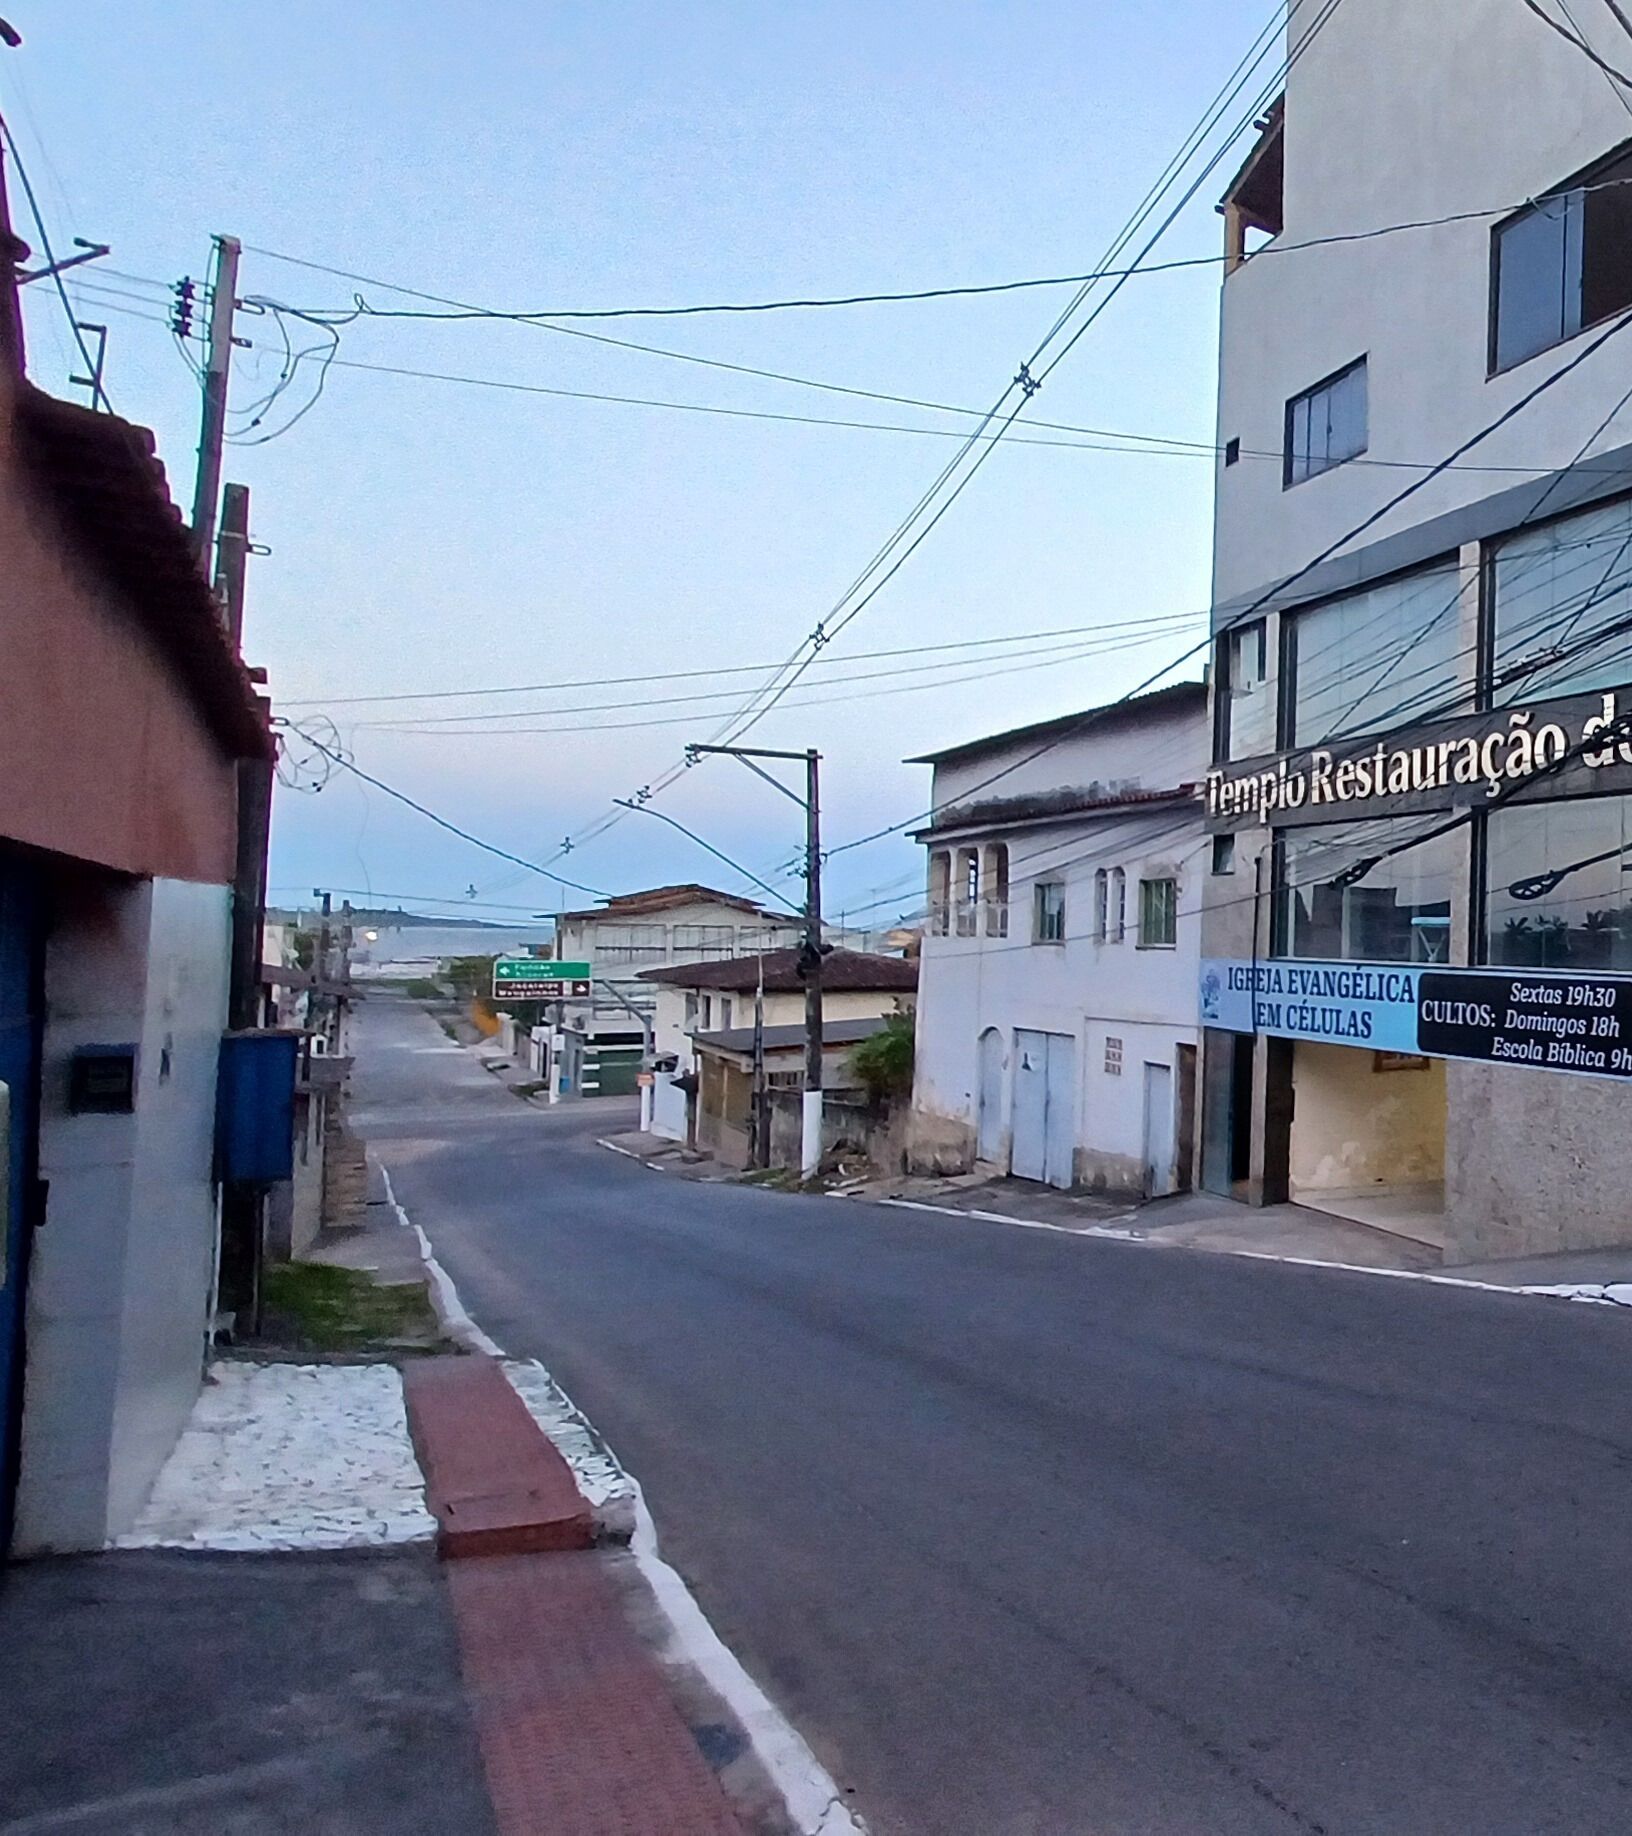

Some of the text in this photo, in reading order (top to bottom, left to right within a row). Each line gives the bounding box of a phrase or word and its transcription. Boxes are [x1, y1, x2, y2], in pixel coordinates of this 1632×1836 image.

[1206, 752, 1304, 824] Templo
[1310, 711, 1567, 798] Restauração
[1227, 964, 1415, 1004] IGREJA EVANGÉLICA
[1510, 982, 1616, 1008] Sextas 19h30
[1256, 999, 1372, 1039] EM CÉLULAS
[1421, 999, 1496, 1028] CULTOS:
[1504, 1009, 1620, 1039] Domingos 18h
[1491, 1037, 1632, 1071] Escola Bíblica 9h
